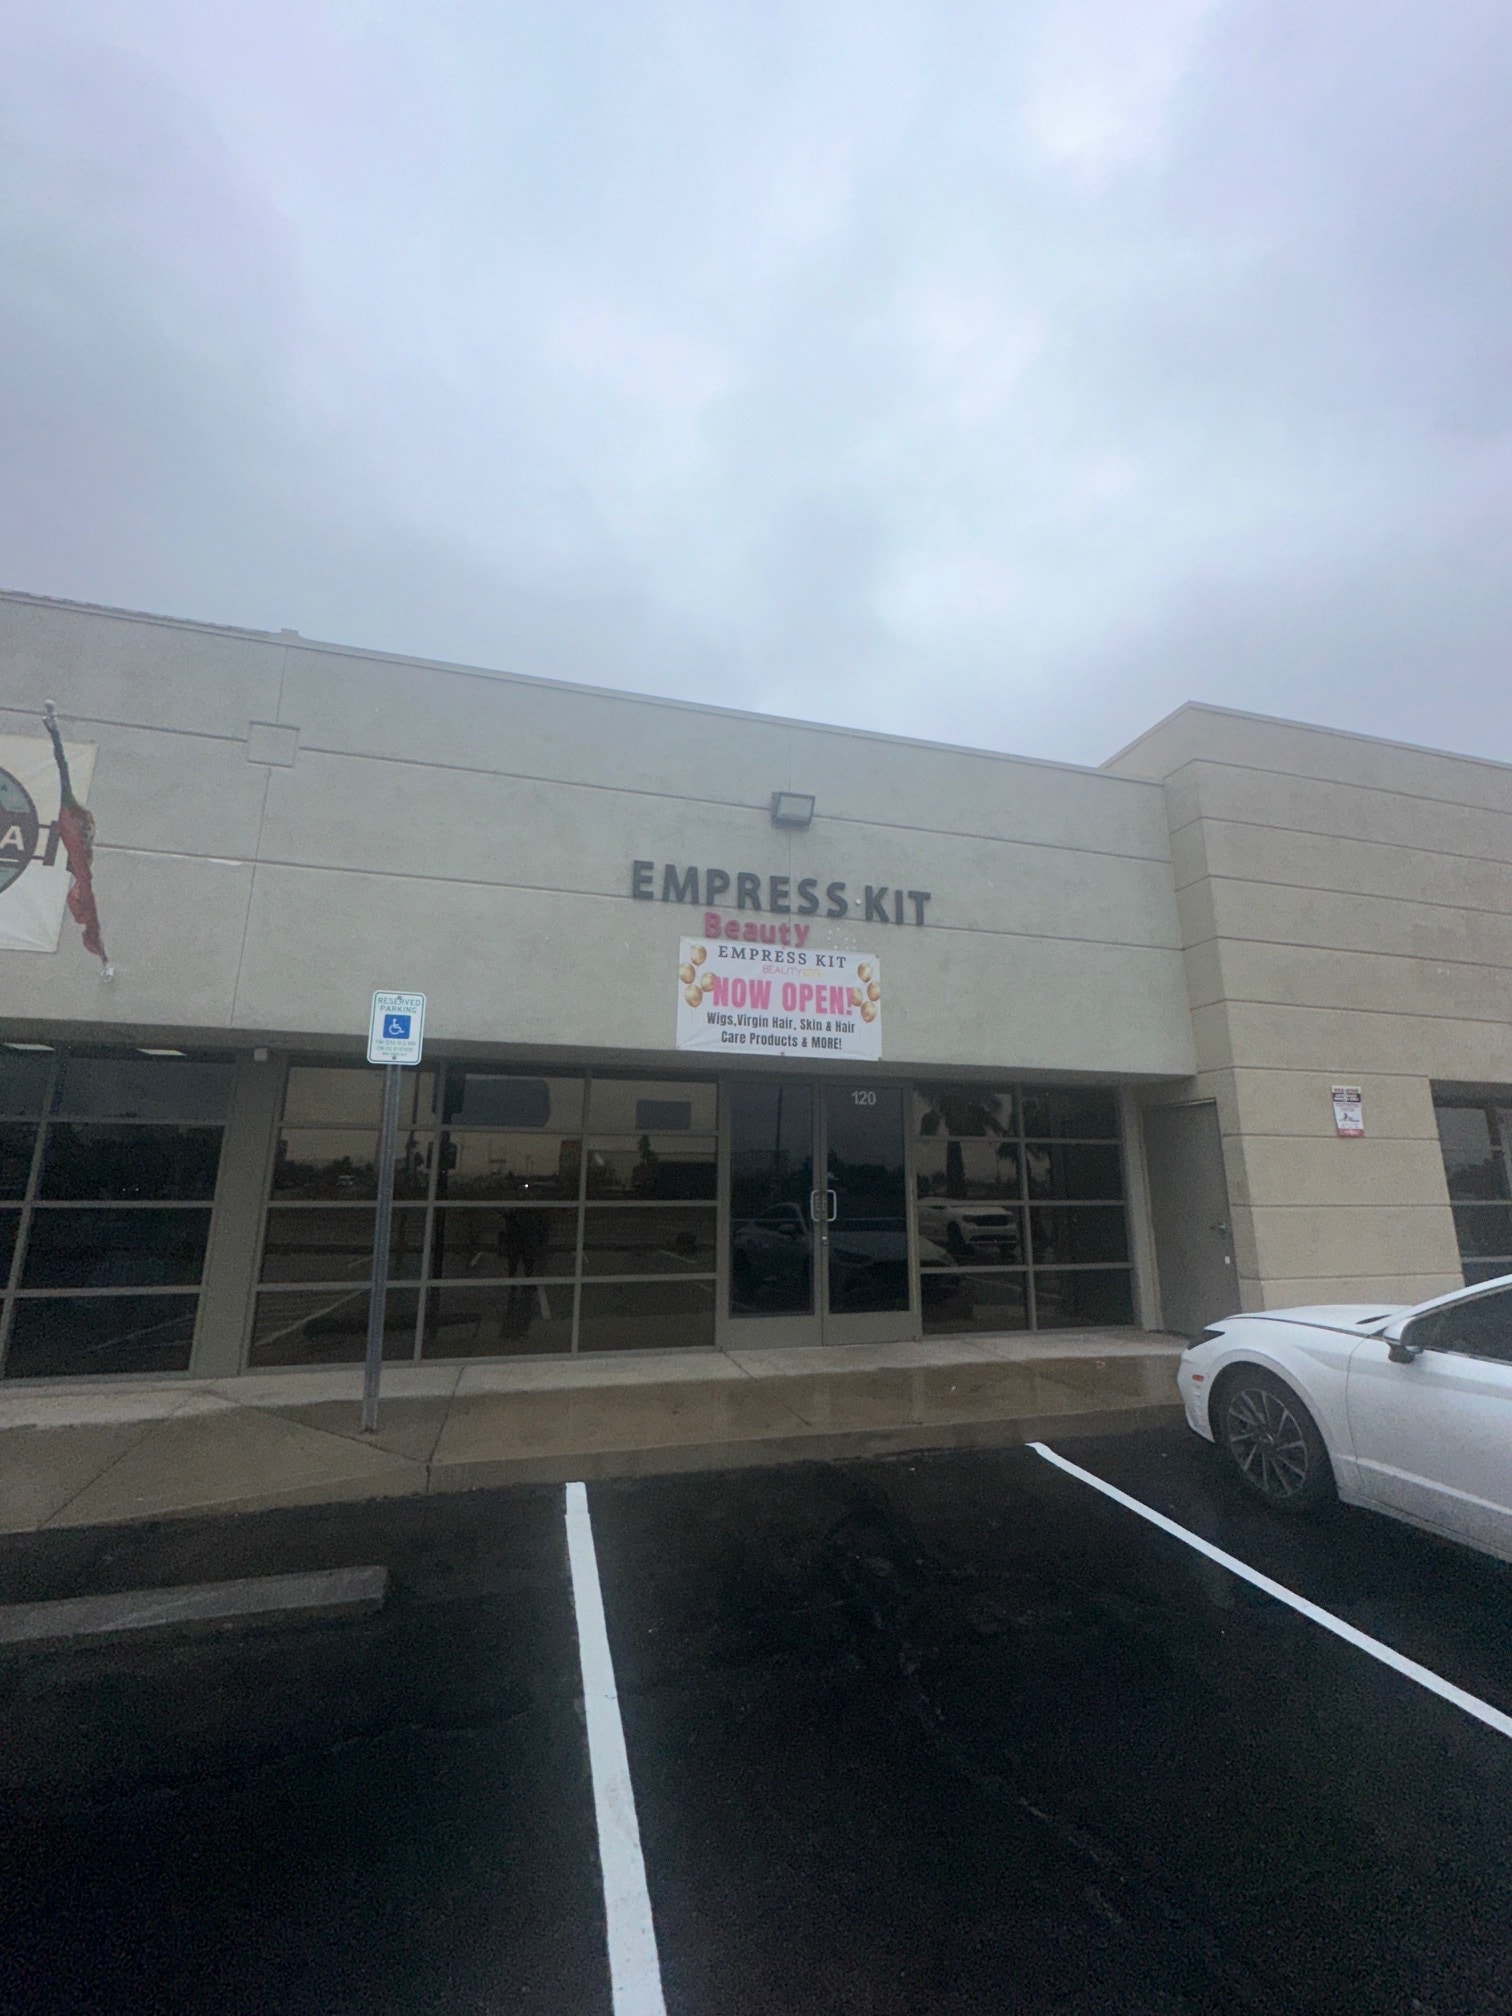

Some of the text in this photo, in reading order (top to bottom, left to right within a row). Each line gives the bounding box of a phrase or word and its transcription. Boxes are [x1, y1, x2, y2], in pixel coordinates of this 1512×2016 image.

[632, 860, 931, 926] EMPRESS KIT
[704, 912, 810, 948] Beauty
[718, 945, 847, 968] EMPRESS KIT
[378, 997, 421, 1006] RESERVED
[713, 976, 853, 1016] NOW OPEN!
[380, 1005, 417, 1014] PARKING
[800, 1018, 823, 1031] Skin
[825, 1021, 832, 1032] &
[835, 1021, 855, 1033] Hair
[721, 1031, 842, 1049] Care Products & MORE!
[852, 1090, 876, 1105] 120
